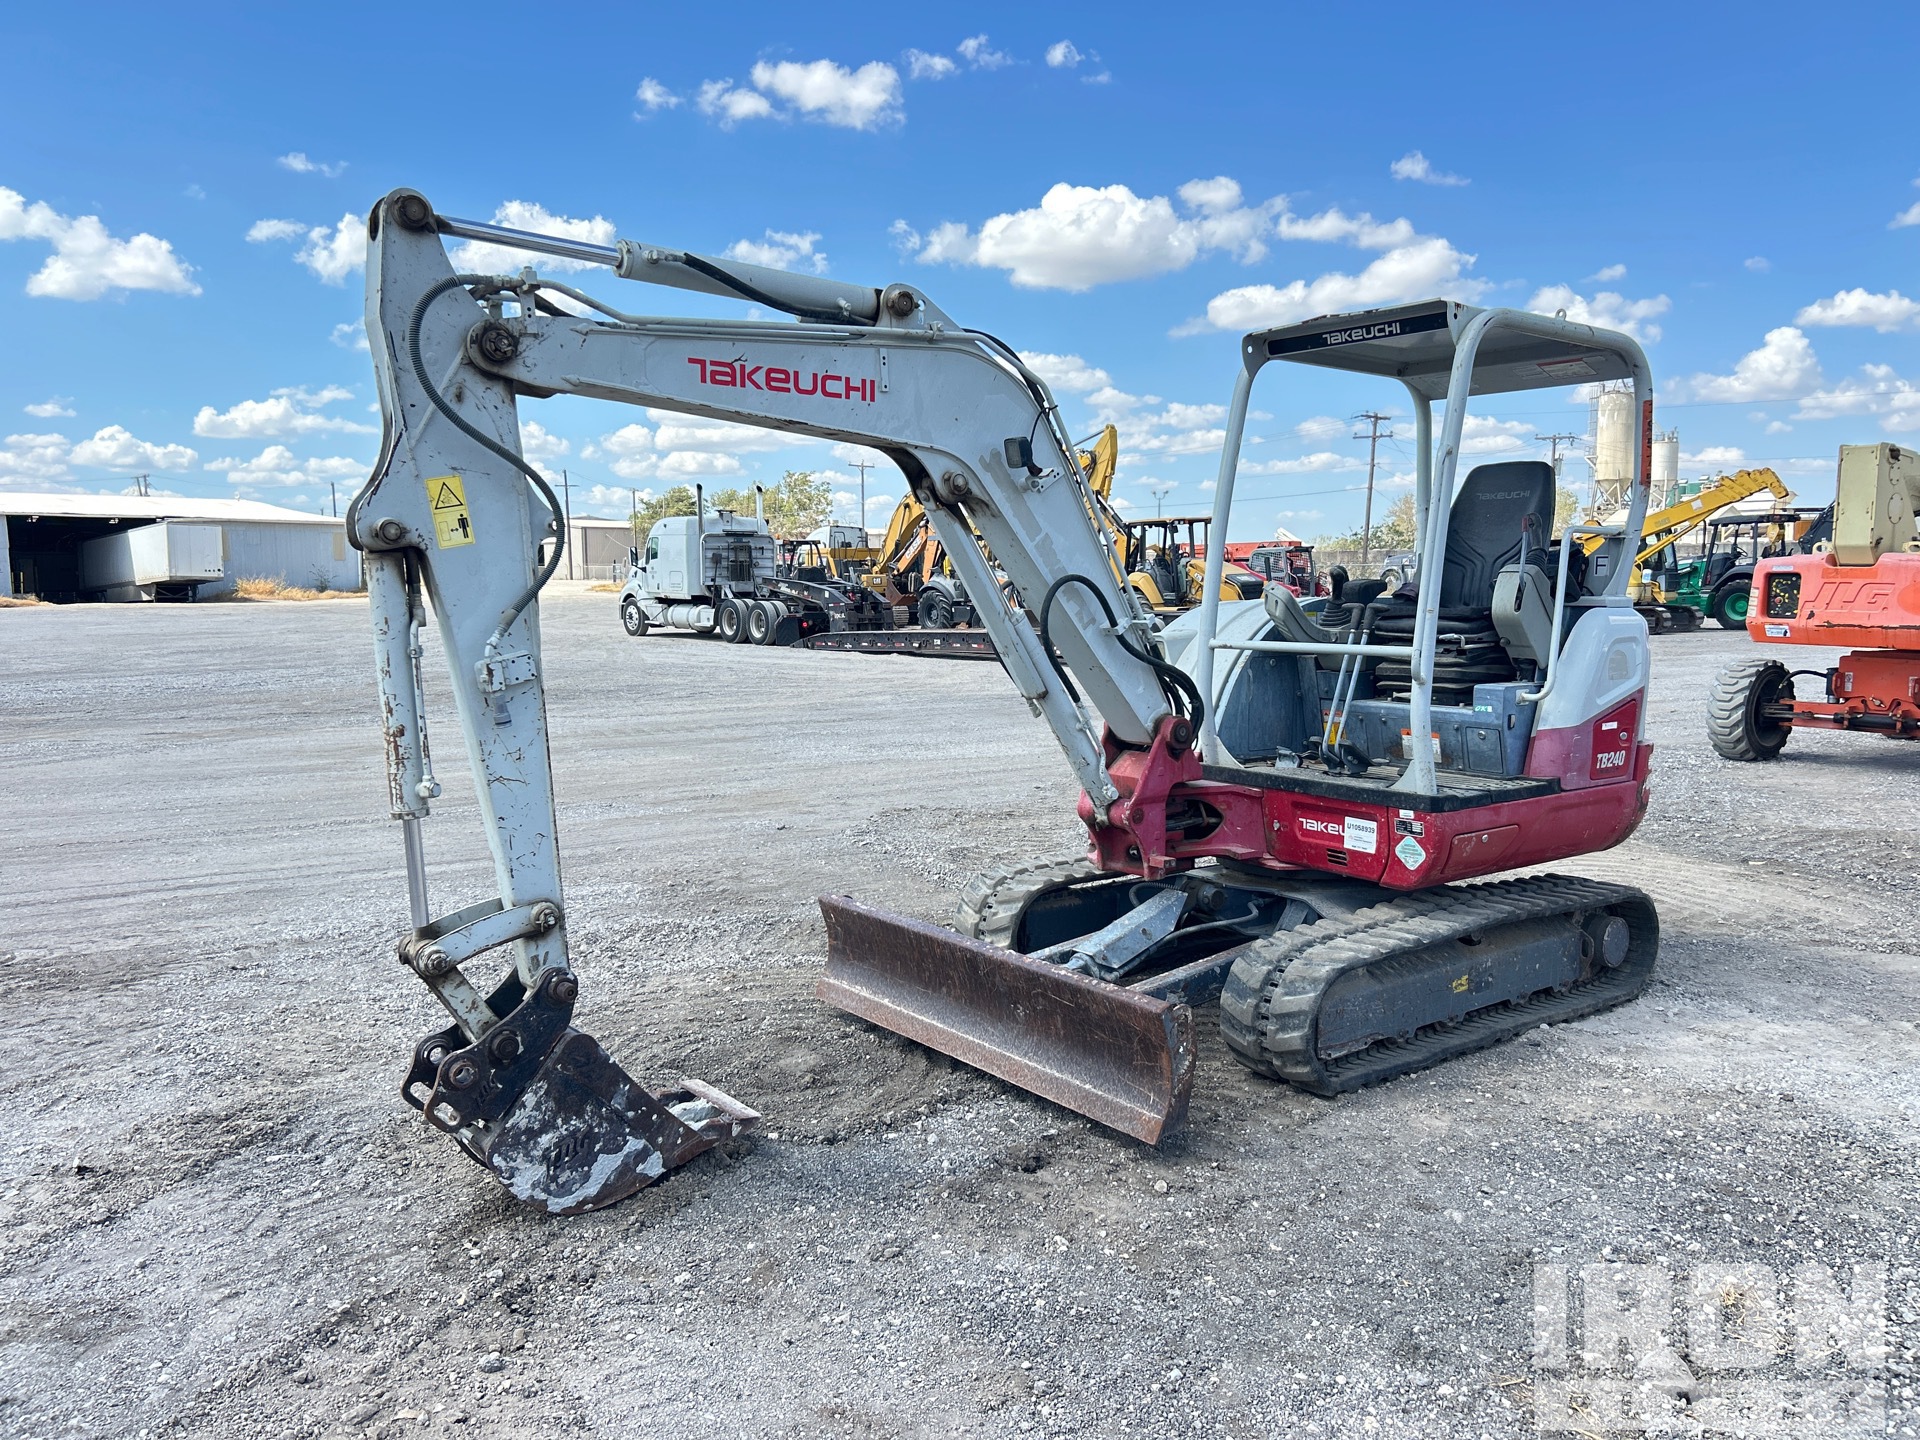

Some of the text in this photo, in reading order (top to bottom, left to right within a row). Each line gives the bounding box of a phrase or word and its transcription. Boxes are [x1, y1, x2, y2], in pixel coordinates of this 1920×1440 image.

[1322, 322, 1401, 345] TAKEUCHI
[687, 357, 876, 402] TAKEUCHI
[1594, 556, 1609, 575] F
[1596, 749, 1626, 769] TB240
